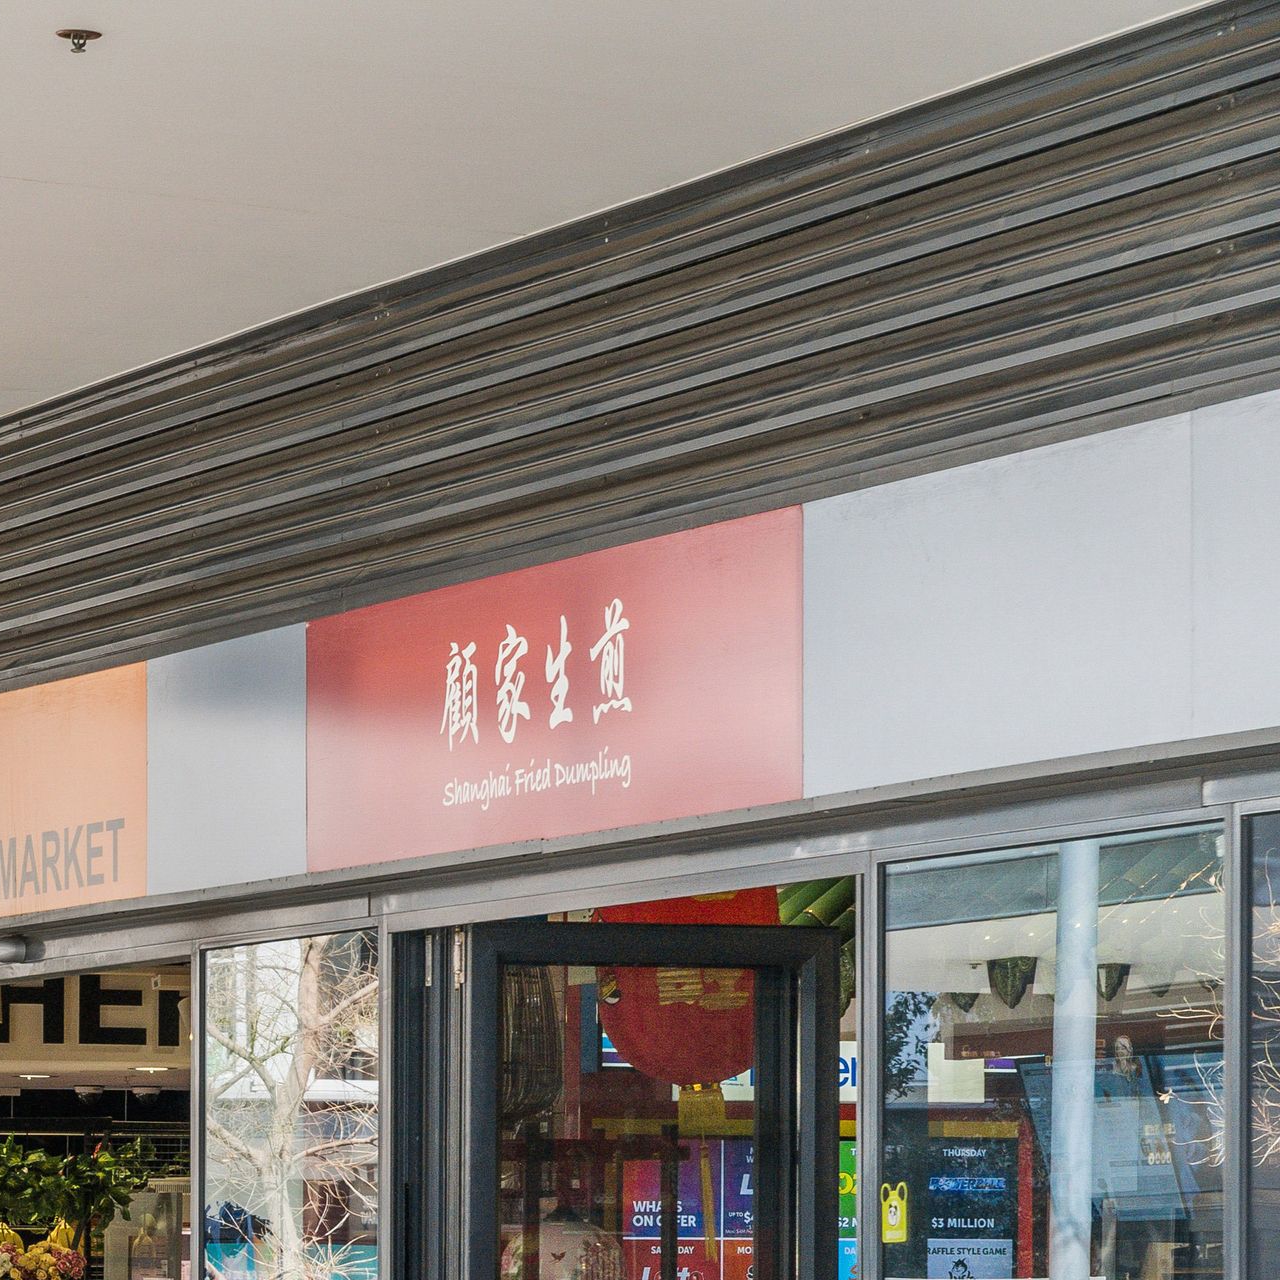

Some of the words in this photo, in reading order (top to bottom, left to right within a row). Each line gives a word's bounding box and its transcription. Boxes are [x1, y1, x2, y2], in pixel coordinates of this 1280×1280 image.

[440, 598, 632, 752] 顧家生煎
[443, 764, 511, 811] Shanghai
[515, 758, 551, 796] Fried
[554, 746, 631, 795] Dumpling
[943, 1149, 987, 1158] THURSDAY
[633, 1199, 683, 1213] WHAS
[633, 1215, 653, 1227] ON
[931, 1217, 944, 1229] $3
[947, 1218, 995, 1228] MILLION
[957, 1247, 981, 1255] STYLE
